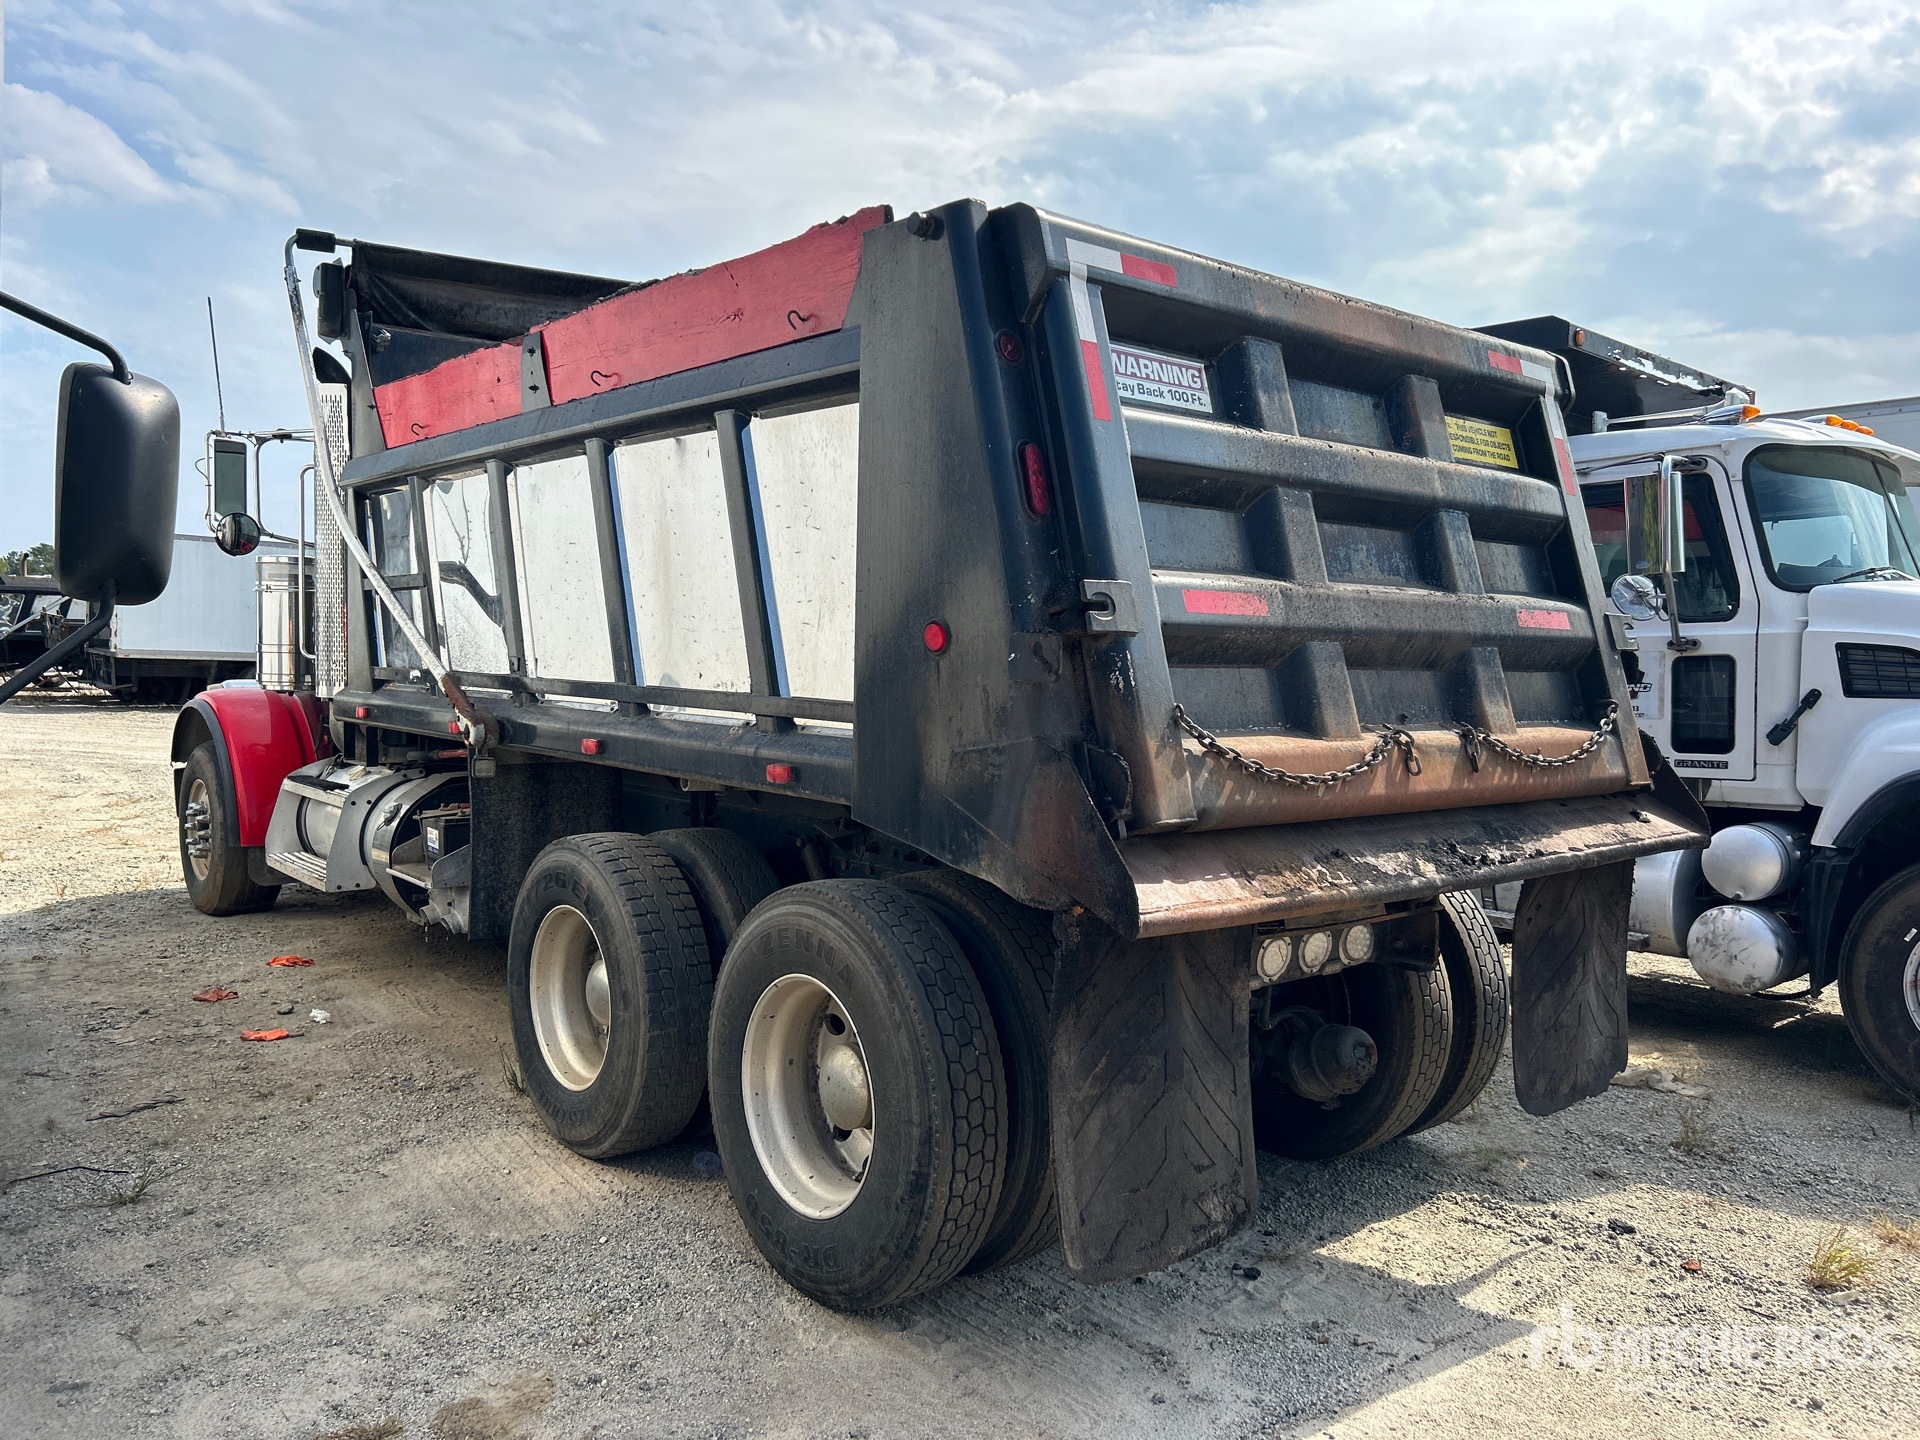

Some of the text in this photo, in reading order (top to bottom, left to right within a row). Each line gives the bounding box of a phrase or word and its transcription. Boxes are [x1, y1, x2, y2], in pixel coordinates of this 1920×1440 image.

[1116, 380, 1207, 407] tay Back 100 Ft.
[1449, 432, 1480, 446] ESPONSIBLE
[1490, 440, 1512, 452] OBJECTS
[1472, 447, 1488, 458] FROM
[1487, 450, 1497, 460] THE
[1496, 452, 1511, 462] ROAD
[759, 926, 854, 993] ZENNA
